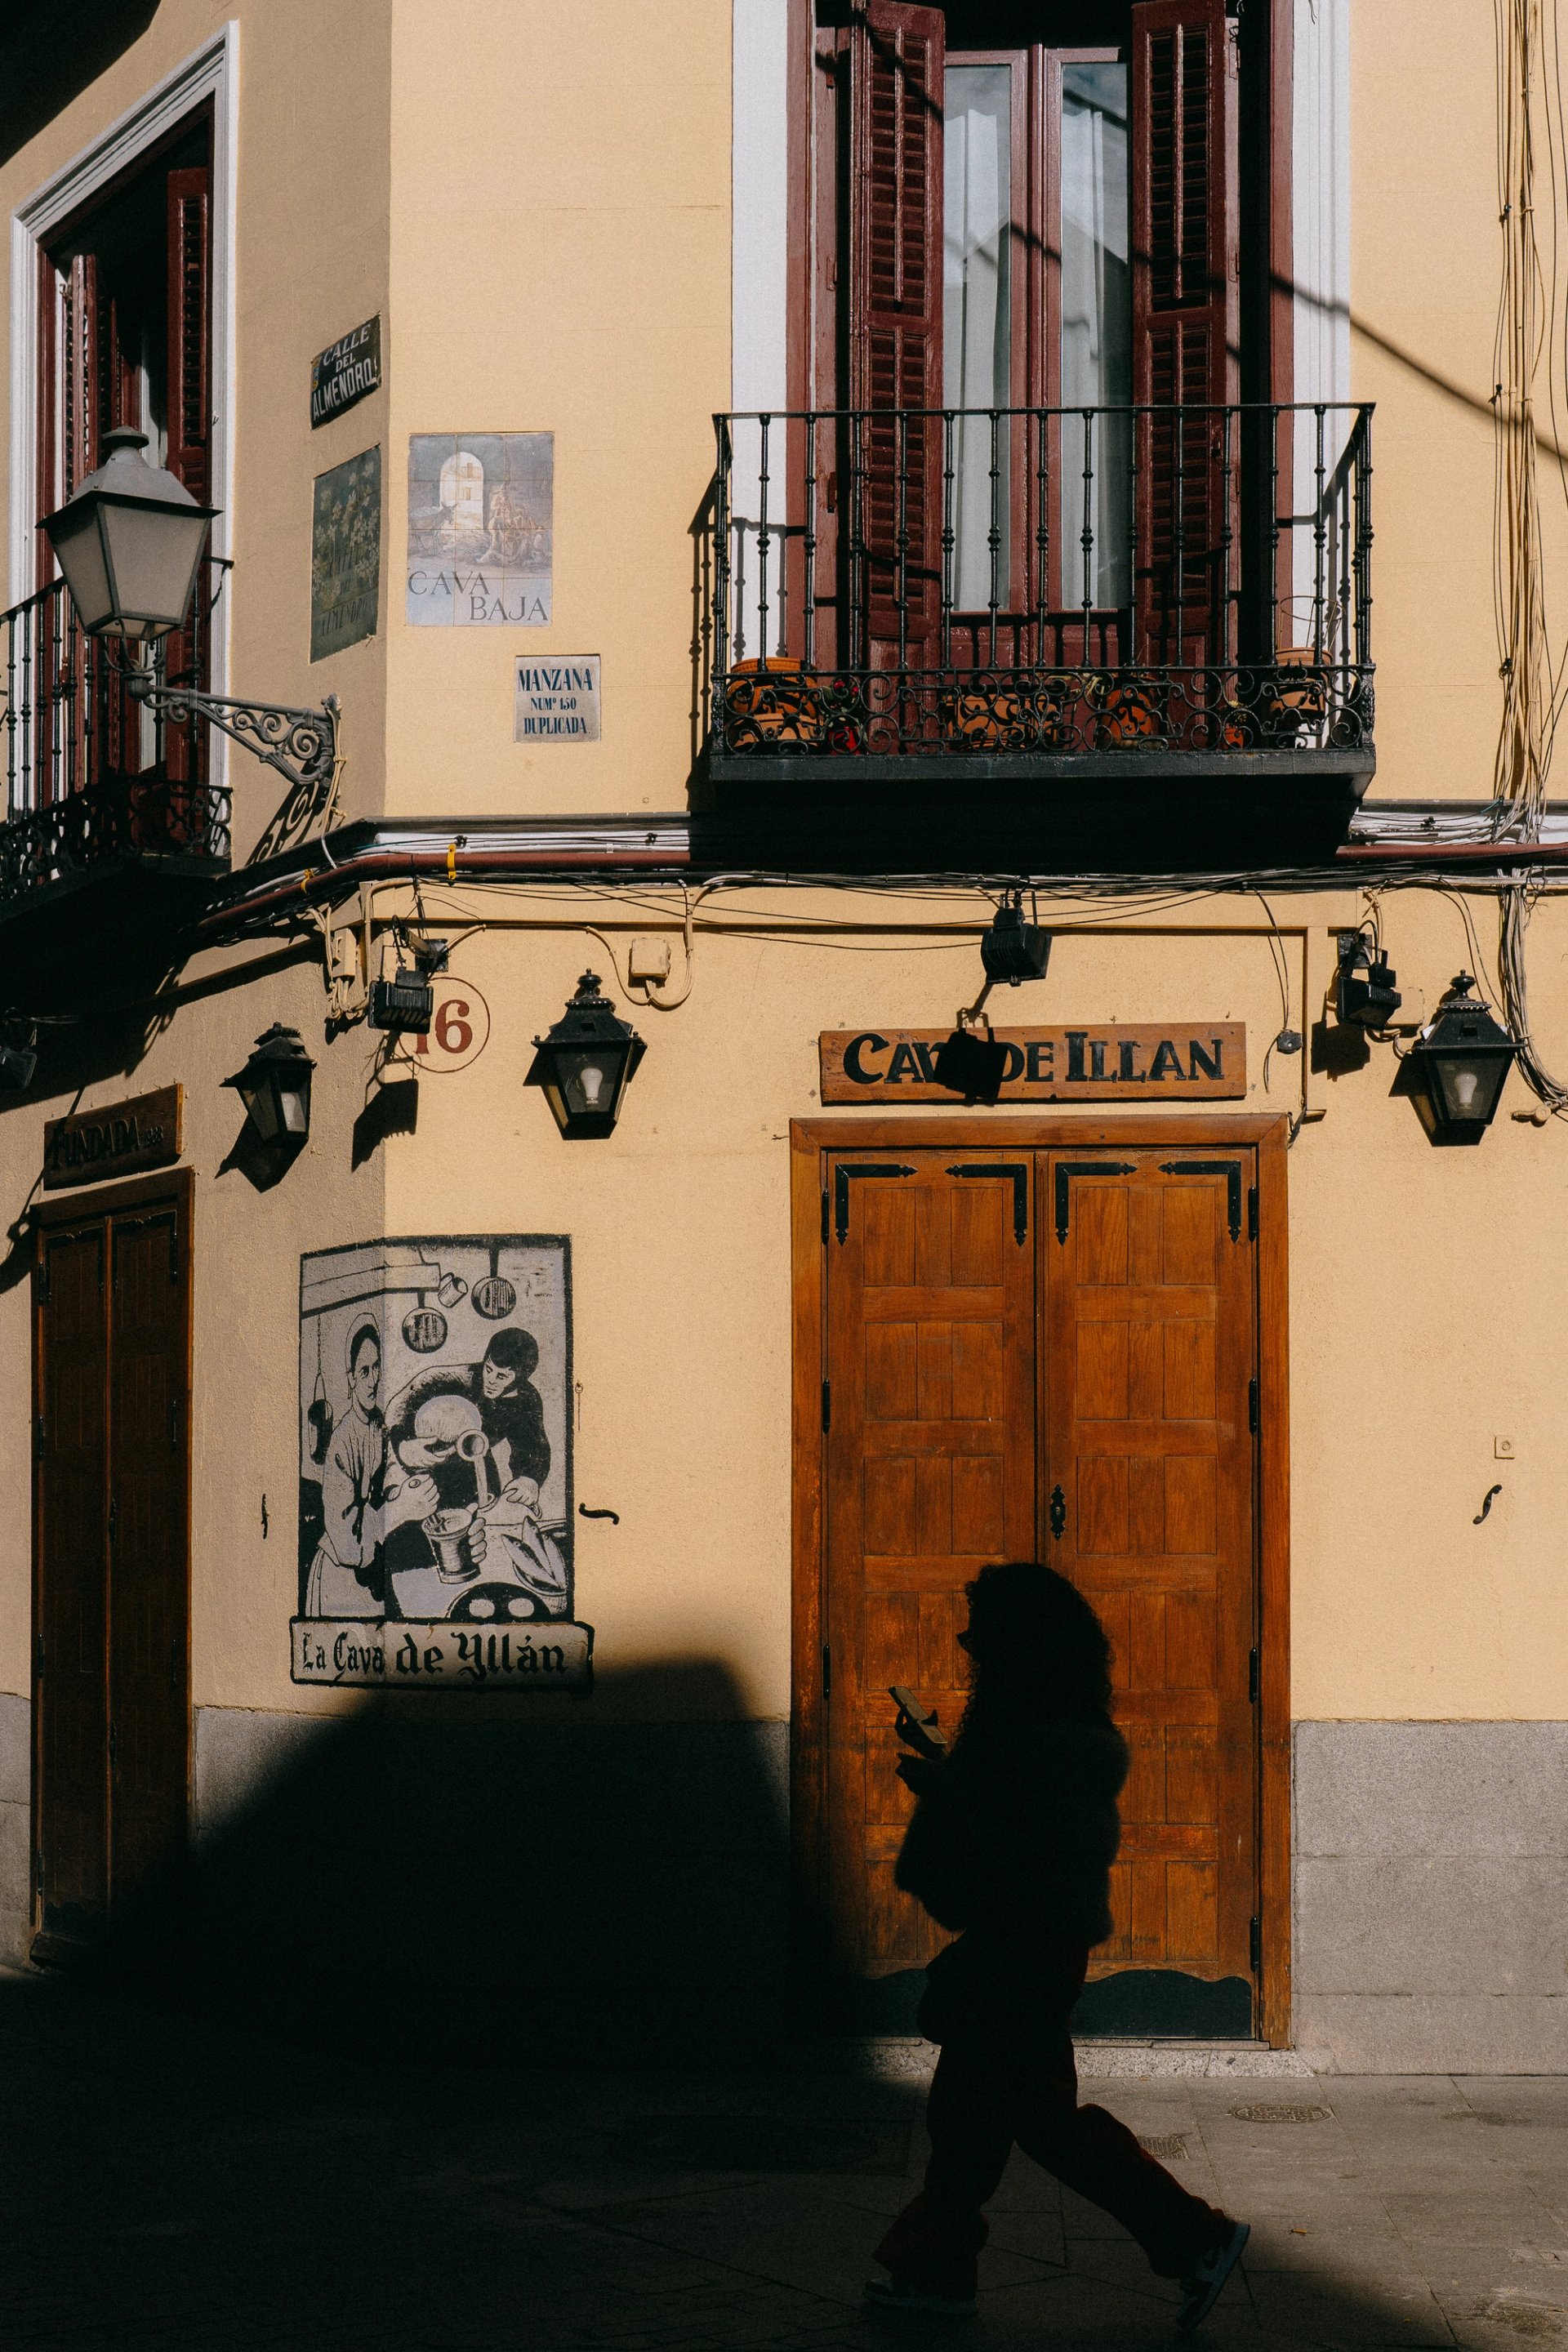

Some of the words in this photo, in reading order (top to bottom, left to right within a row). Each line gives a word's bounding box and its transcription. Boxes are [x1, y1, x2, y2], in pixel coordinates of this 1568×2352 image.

[323, 324, 370, 366] CALLE
[336, 352, 356, 373] DEL
[314, 358, 373, 421] ALMENDRO
[408, 571, 490, 595] CAVA
[470, 595, 549, 621] BAJA
[518, 668, 594, 692] MANZANA
[559, 697, 577, 710] 150
[1064, 1031, 1225, 1084] ILLAN
[51, 1116, 142, 1172] FUNDADA
[302, 1631, 327, 1672] La
[396, 1633, 445, 1675] de
